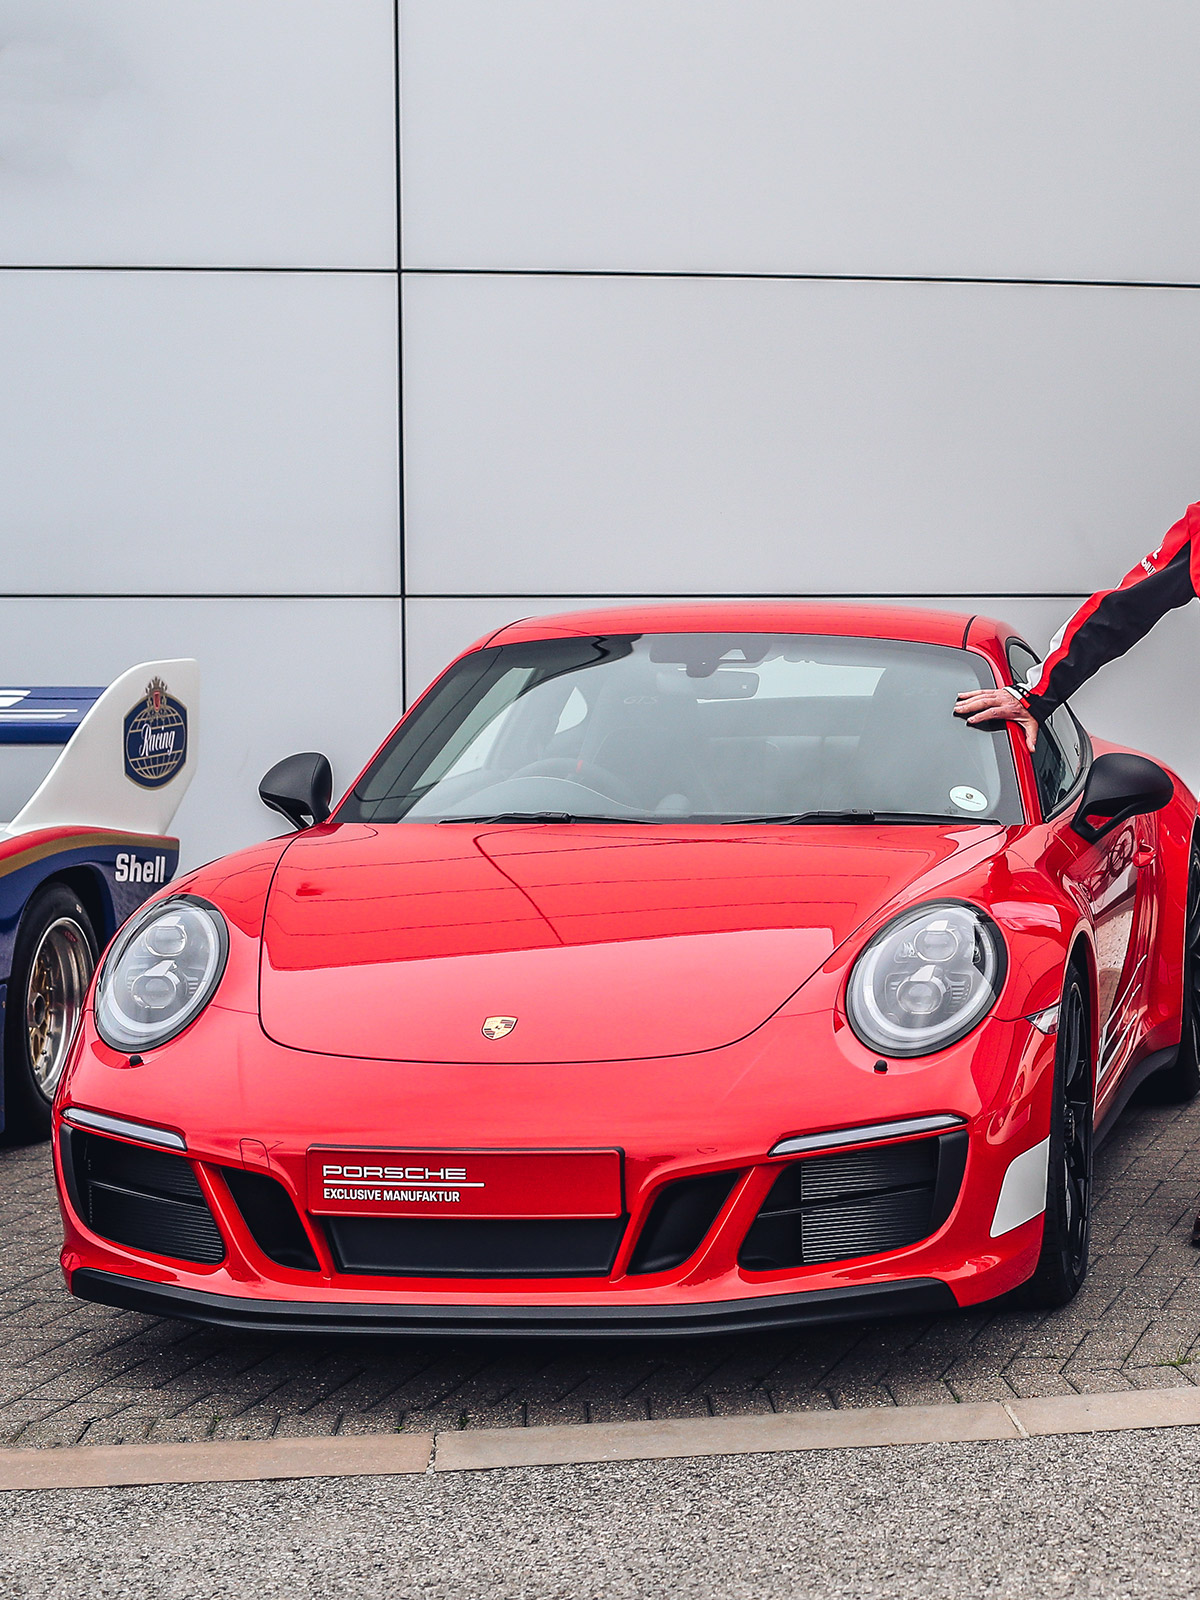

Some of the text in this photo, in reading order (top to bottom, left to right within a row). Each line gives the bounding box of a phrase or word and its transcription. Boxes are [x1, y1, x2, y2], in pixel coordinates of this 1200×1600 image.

[139, 723, 176, 757] Racing
[115, 853, 166, 883] Shell
[322, 1164, 467, 1180] PORSCHE
[323, 1188, 460, 1203] EXCLUSIVE MANUFAKTUR
